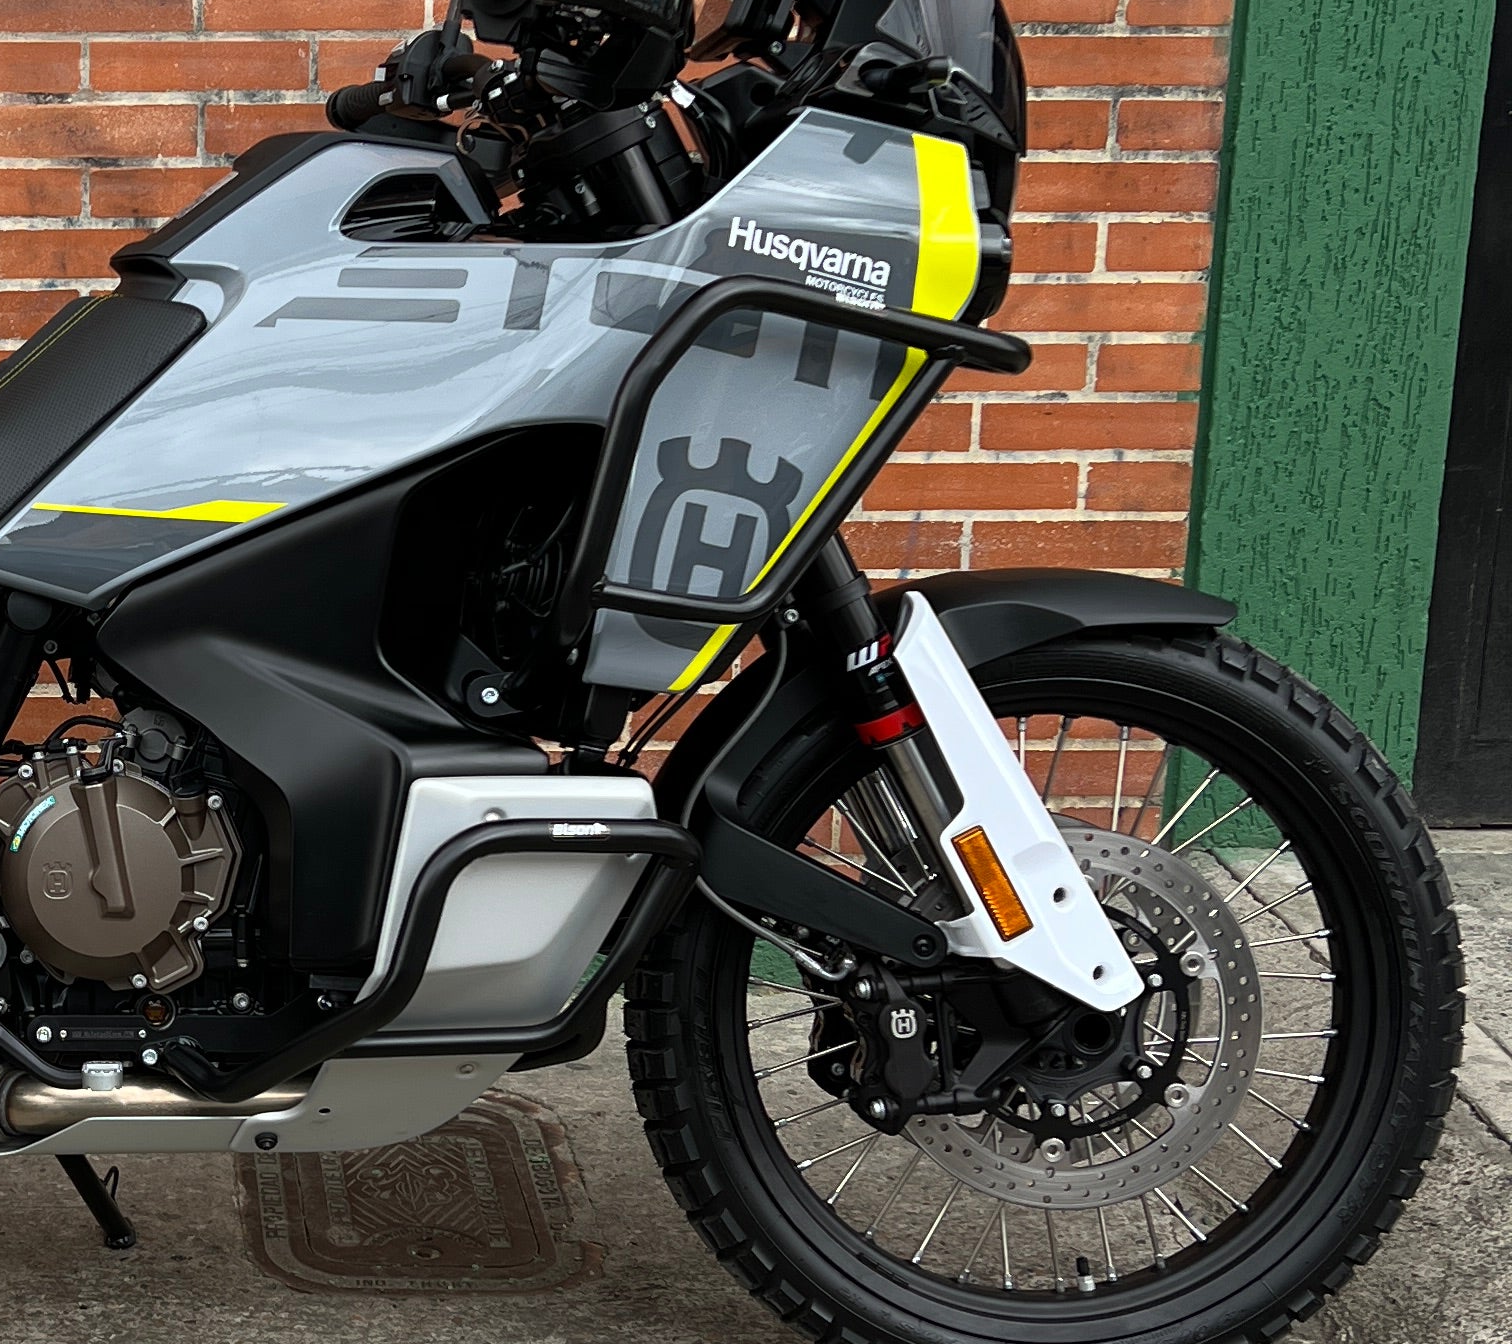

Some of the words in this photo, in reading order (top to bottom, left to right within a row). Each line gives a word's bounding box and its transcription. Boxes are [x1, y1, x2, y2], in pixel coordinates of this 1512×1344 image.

[727, 216, 891, 287] Husqvarna
[804, 275, 886, 304] MOTORCYCLES
[1329, 781, 1427, 999] SCORPION
